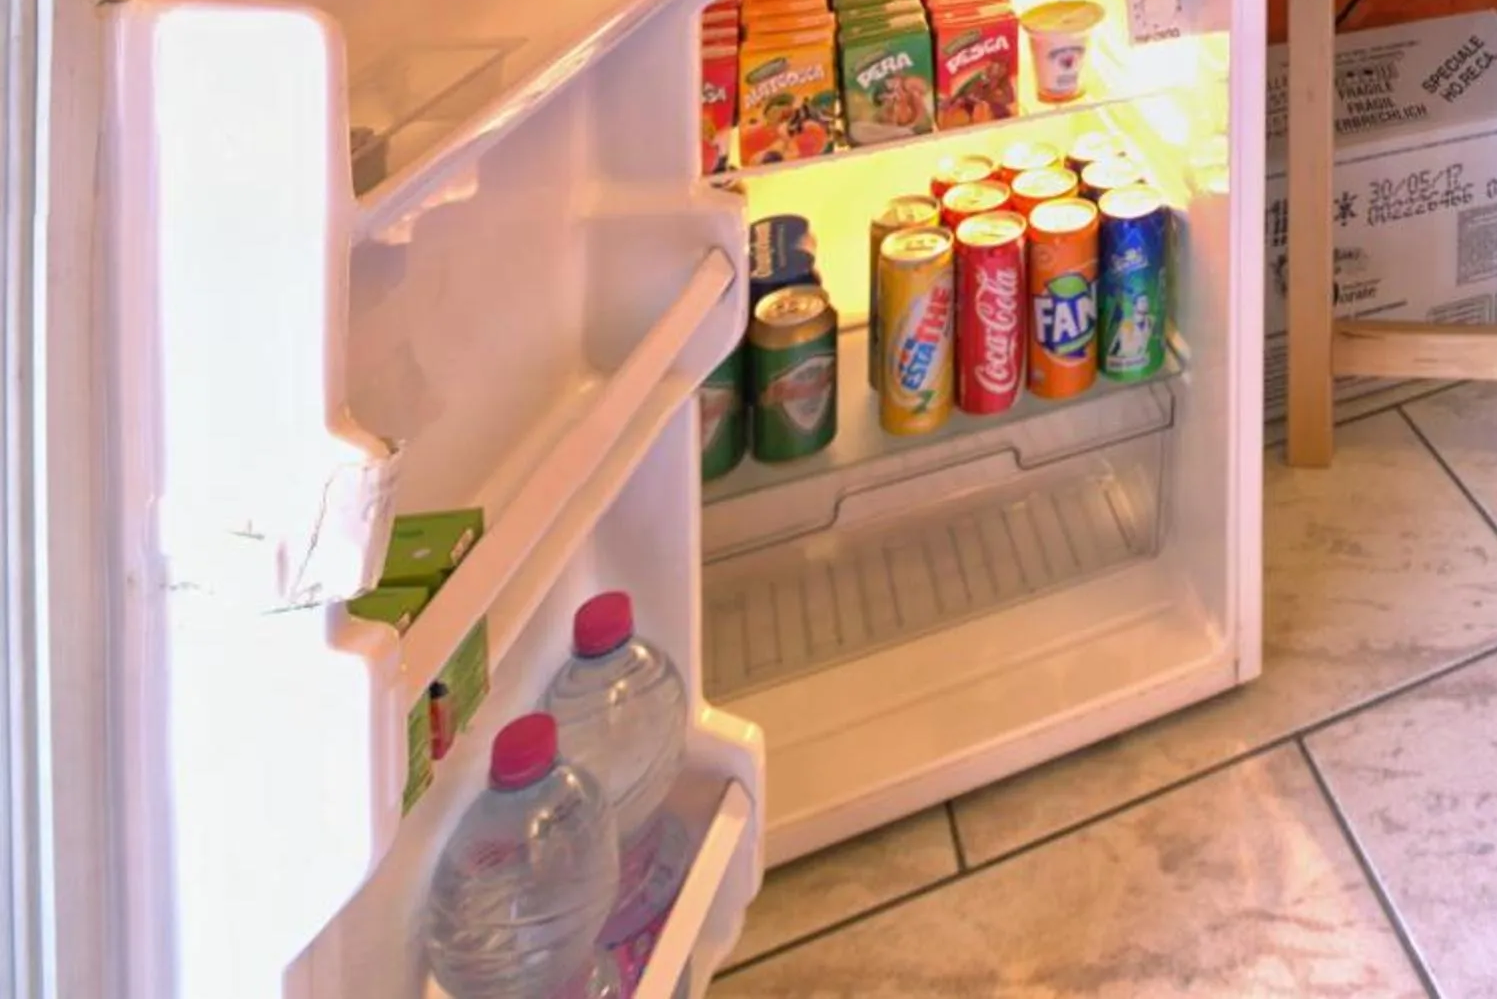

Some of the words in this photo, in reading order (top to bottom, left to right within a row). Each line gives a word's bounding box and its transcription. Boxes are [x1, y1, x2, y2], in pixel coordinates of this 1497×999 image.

[857, 52, 914, 89] PERA
[946, 36, 1010, 75] PESCA
[1422, 35, 1485, 94] SPECIALE
